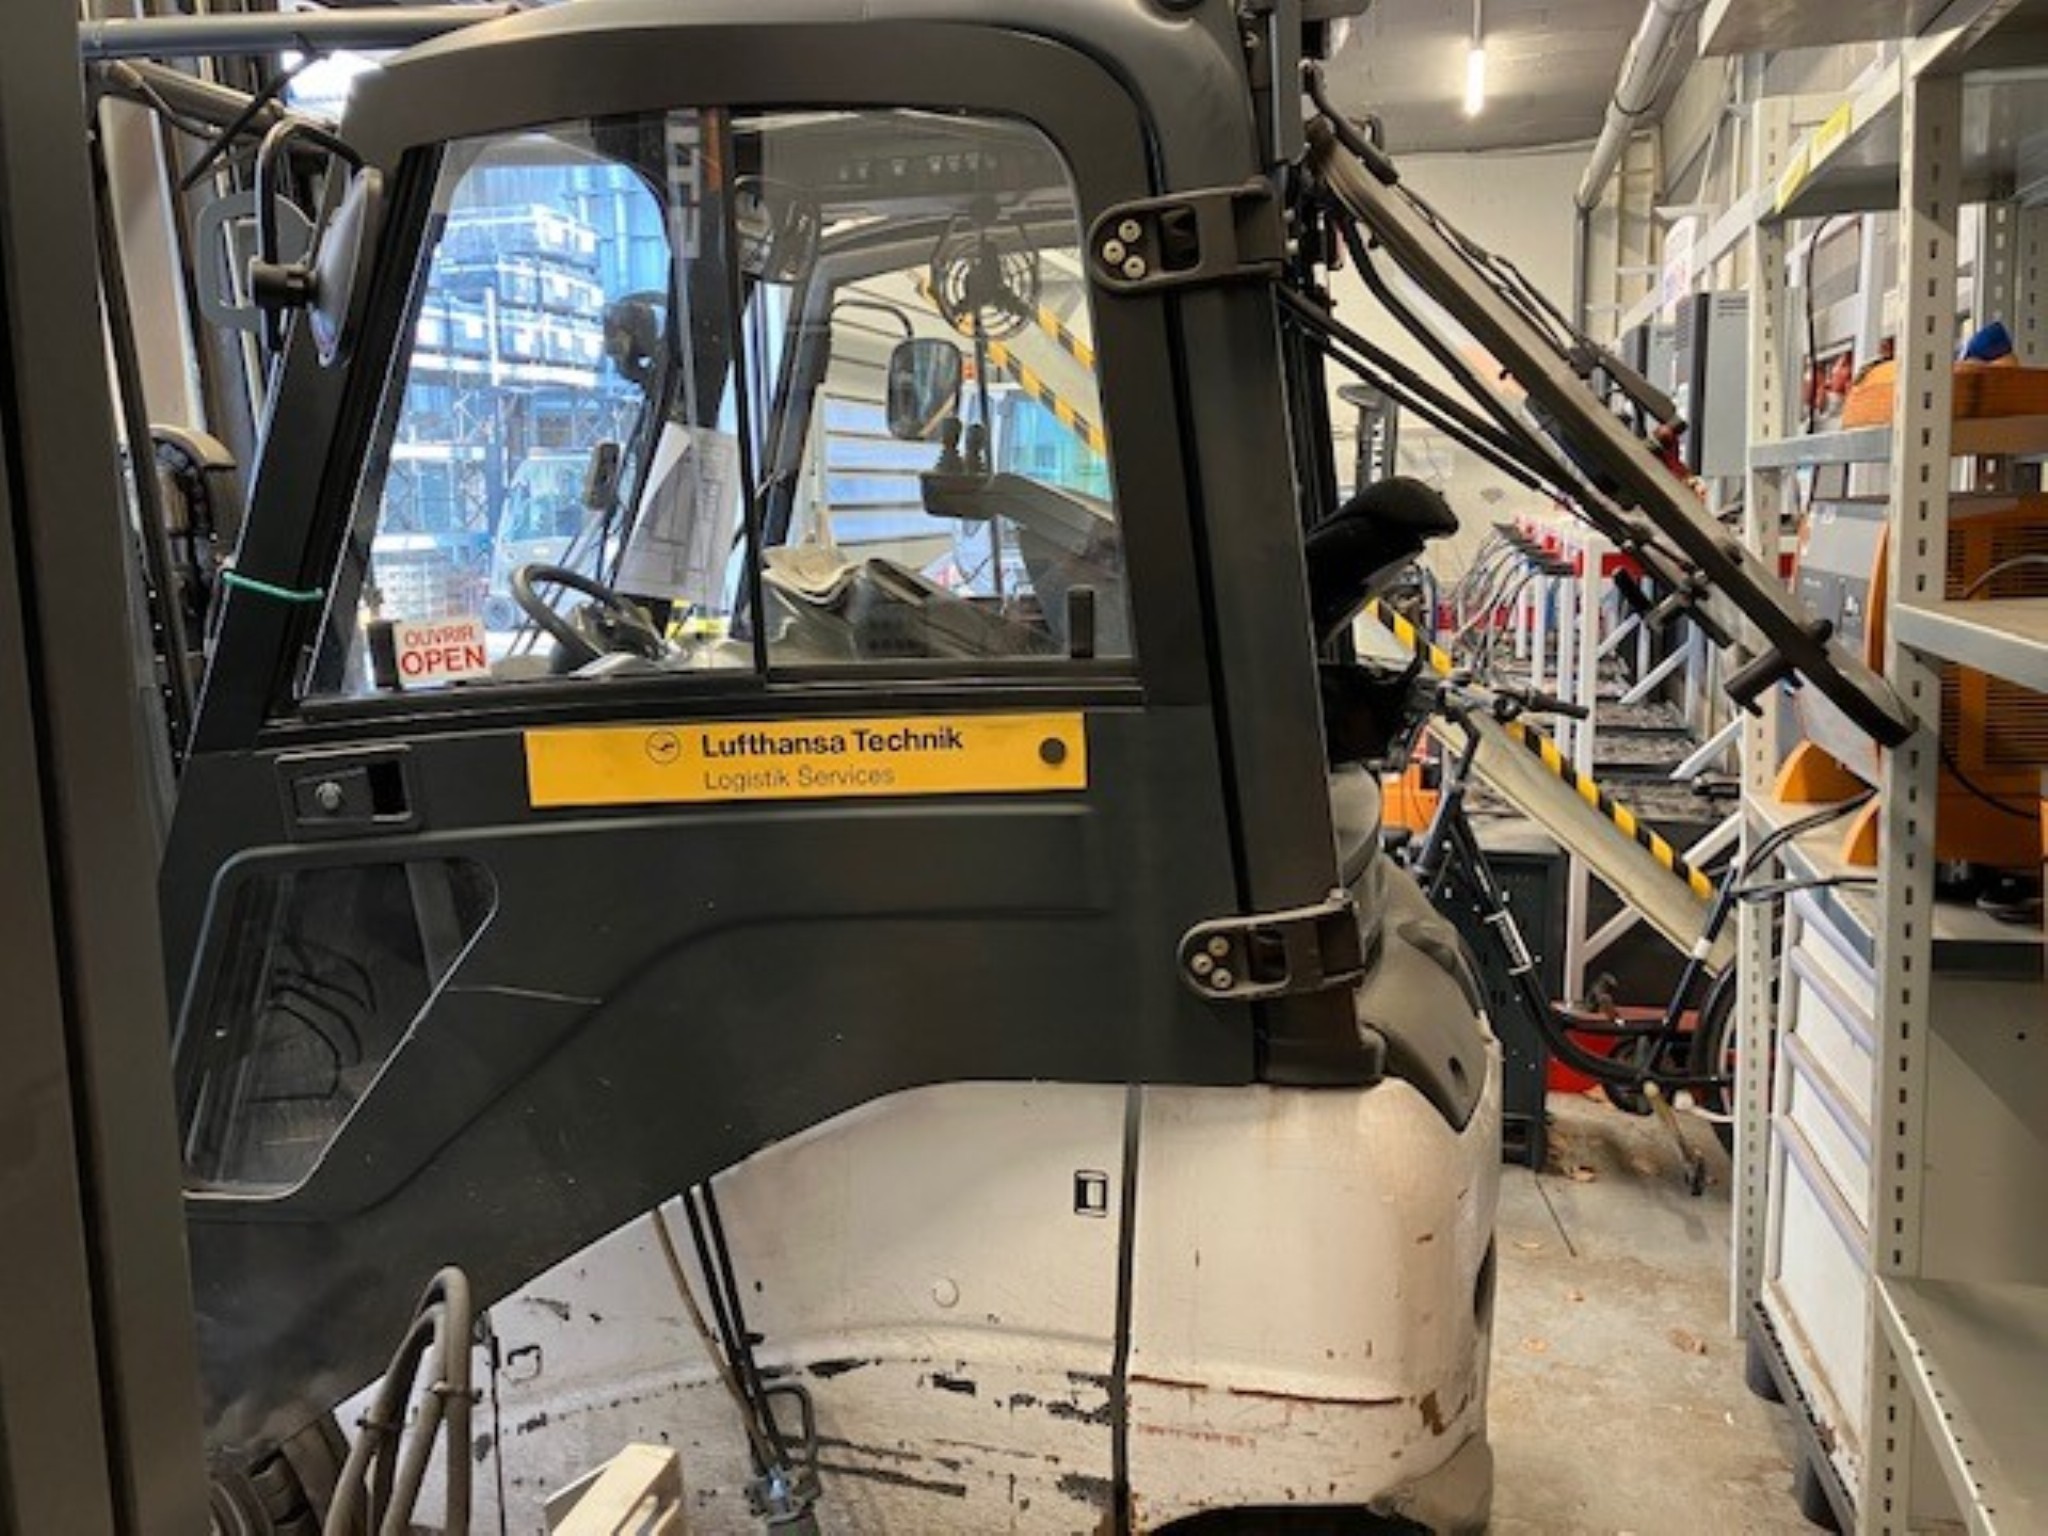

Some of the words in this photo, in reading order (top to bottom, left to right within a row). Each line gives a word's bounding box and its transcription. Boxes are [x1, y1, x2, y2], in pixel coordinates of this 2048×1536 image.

[404, 624, 474, 647] OUVRIR
[401, 645, 485, 675] OPEN
[702, 731, 846, 758] Lufthansa
[853, 727, 963, 752] Technik
[705, 767, 791, 793] Logistik
[798, 763, 895, 787] Services
